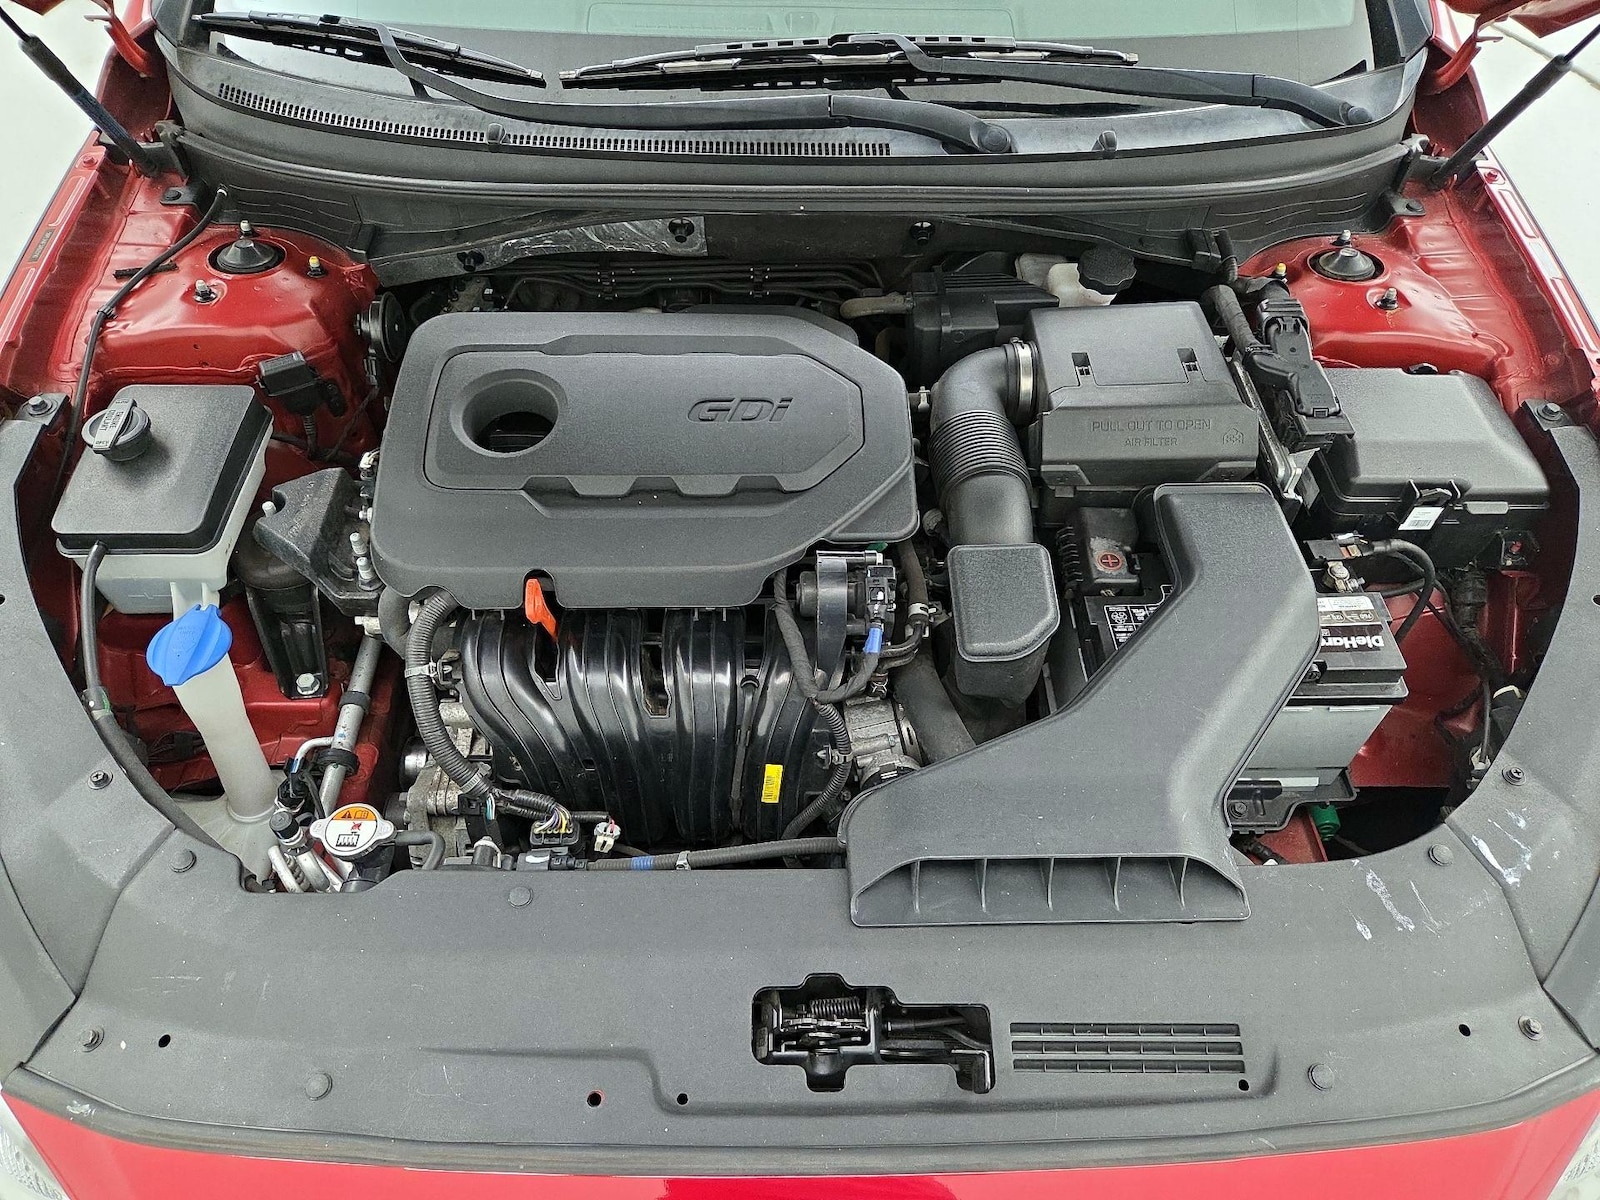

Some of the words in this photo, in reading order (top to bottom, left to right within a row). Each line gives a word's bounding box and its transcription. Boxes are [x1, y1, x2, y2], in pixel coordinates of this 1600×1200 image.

[687, 397, 794, 423] GDi
[1091, 420, 1124, 432] PULL
[1127, 420, 1152, 431] OUT
[1157, 420, 1173, 431] TO
[1176, 418, 1212, 430] OPEN
[1124, 437, 1141, 447] AIR
[1144, 437, 1178, 446] FILTER
